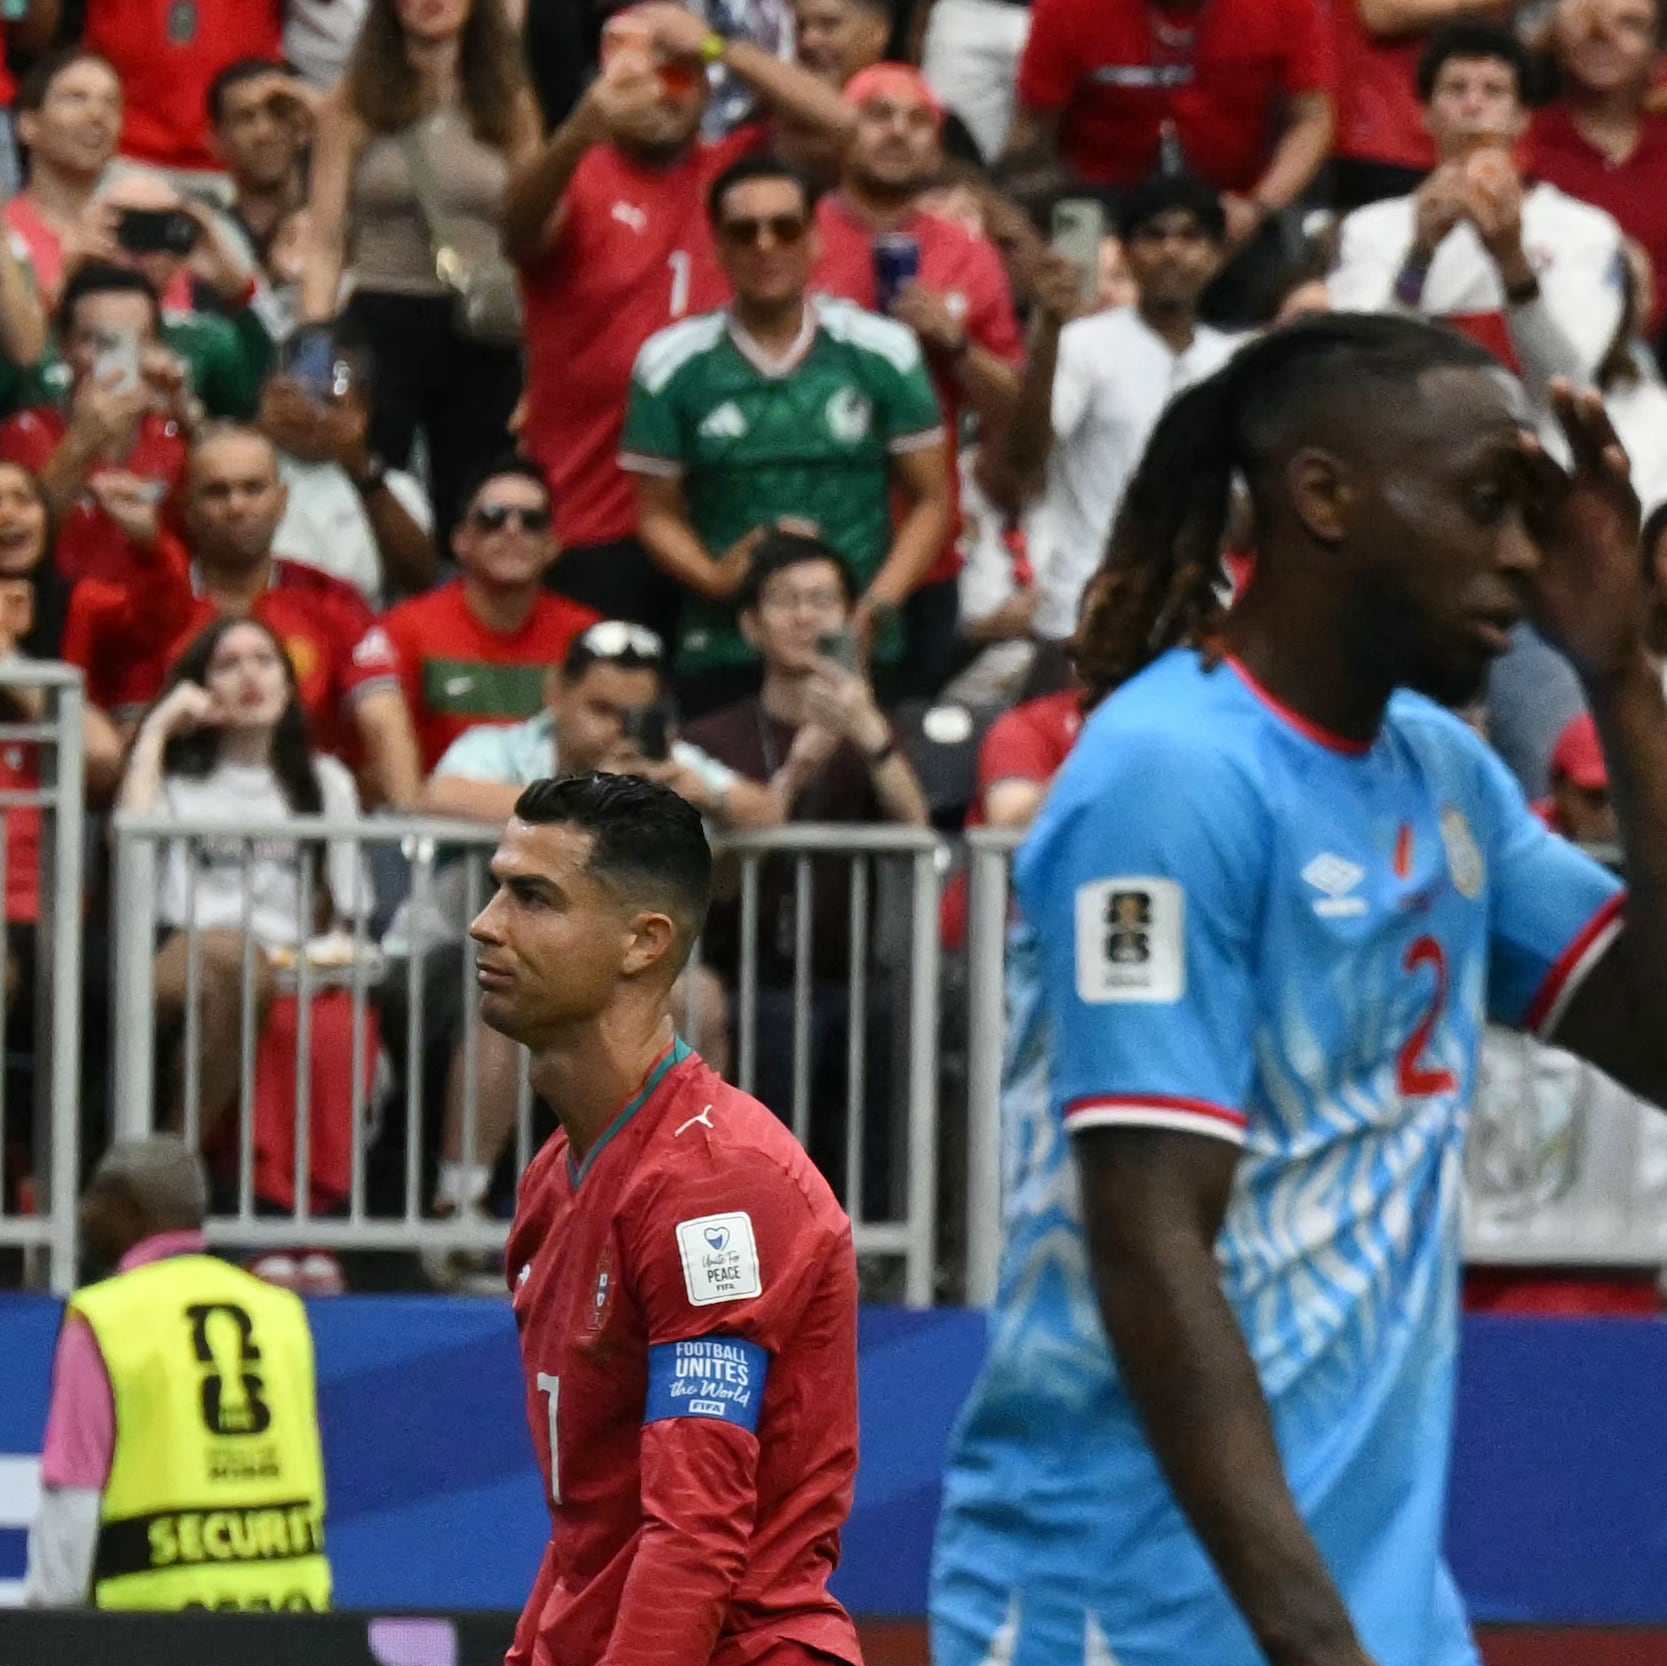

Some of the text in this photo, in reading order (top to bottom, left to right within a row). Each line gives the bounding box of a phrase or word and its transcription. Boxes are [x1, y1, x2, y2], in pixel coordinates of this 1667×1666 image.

[1395, 934, 1459, 1097] 2
[727, 1250, 740, 1266] For
[707, 1265, 741, 1283] PEACE
[716, 1283, 735, 1291] FIFA
[676, 1341, 749, 1366] FOOTBALL
[675, 1358, 750, 1387] UNITES
[669, 1378, 750, 1408] the World
[693, 1401, 722, 1414] FIFA
